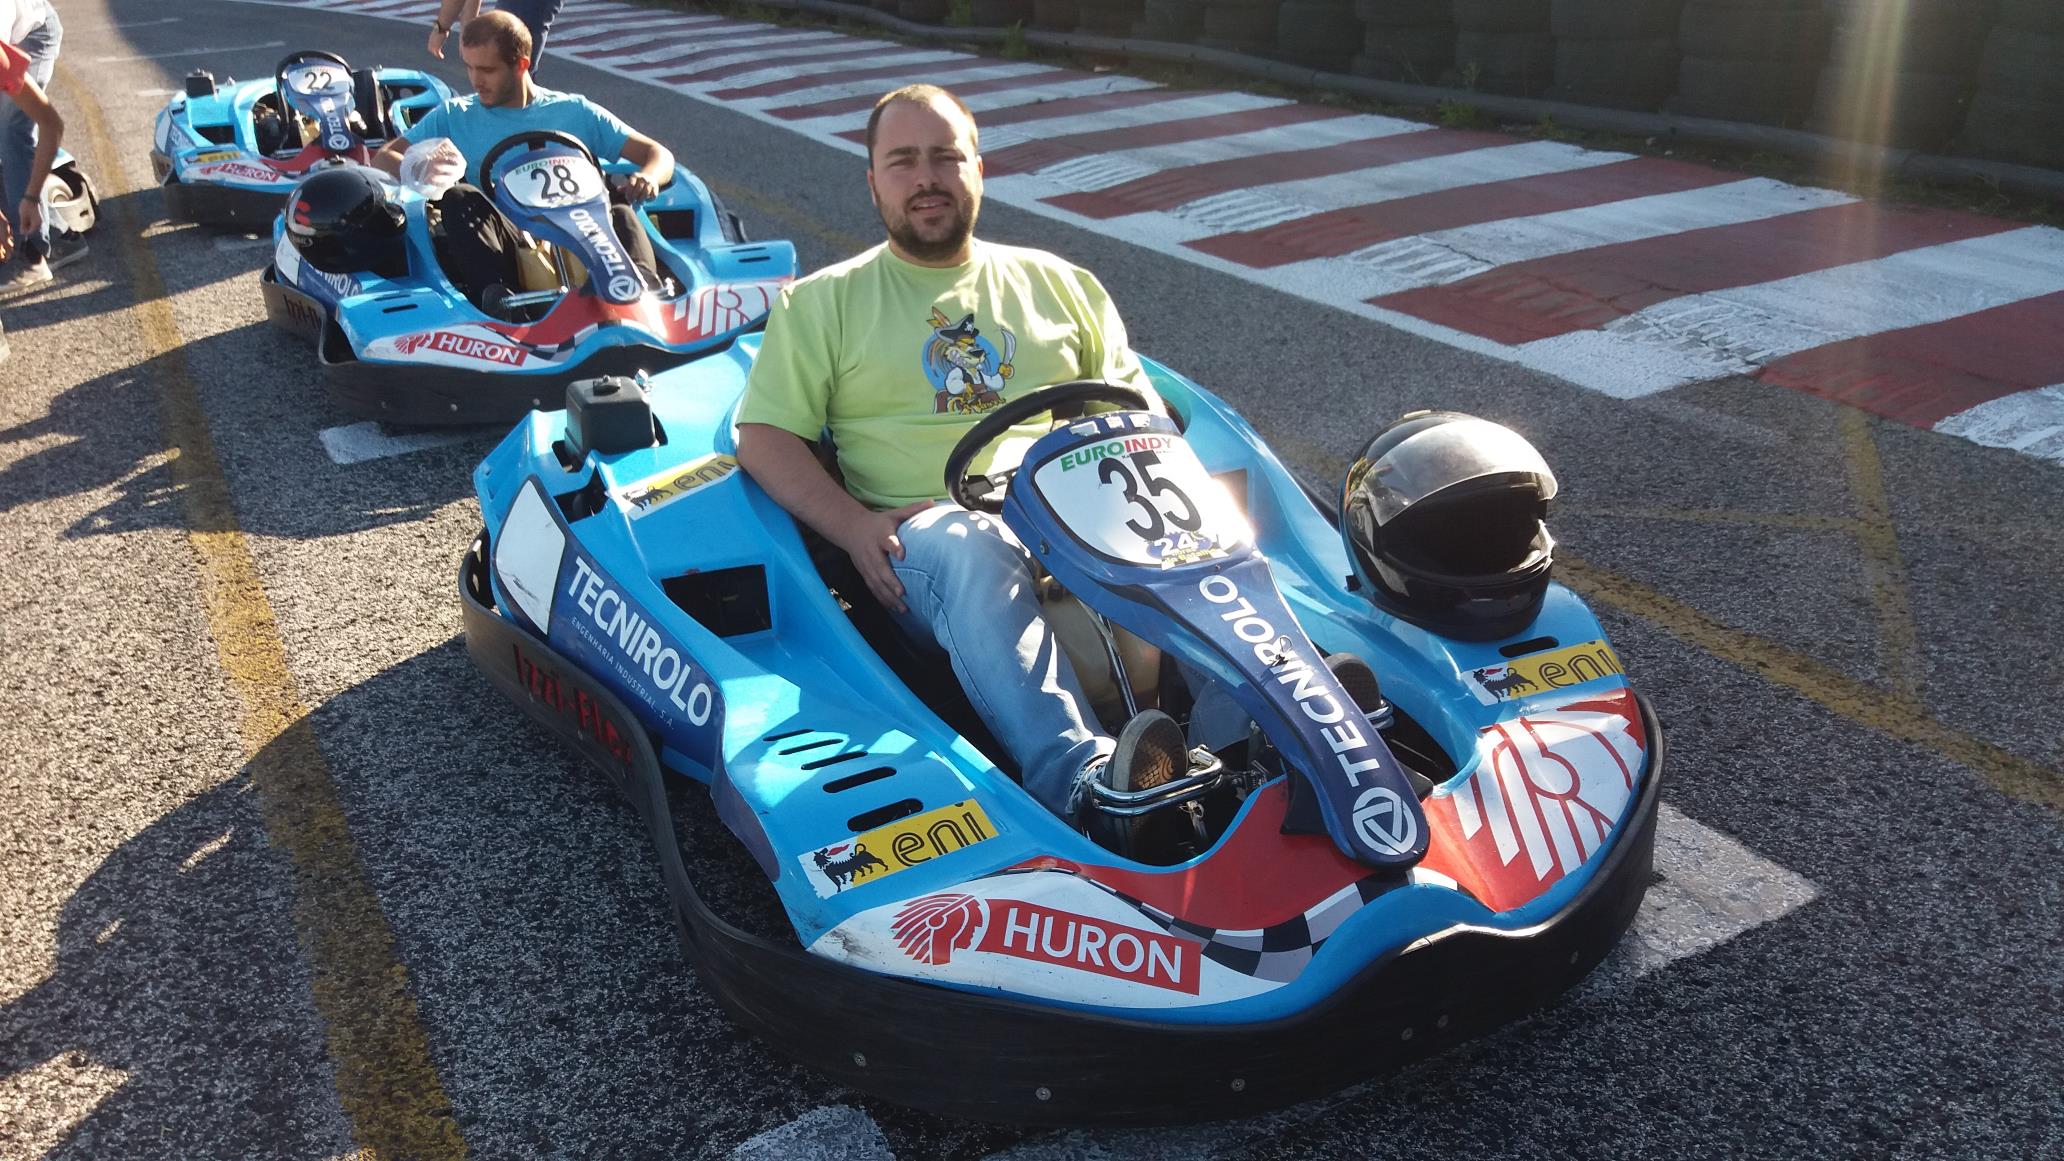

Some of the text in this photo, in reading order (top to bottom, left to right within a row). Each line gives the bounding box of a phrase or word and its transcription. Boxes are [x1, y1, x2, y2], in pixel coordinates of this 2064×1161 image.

[304, 71, 335, 90] 22
[530, 165, 580, 200] 28
[437, 333, 521, 364] HURON
[1059, 436, 1173, 472] EUROINDY
[1097, 449, 1202, 542] 35
[566, 554, 712, 727] TECNIROLO
[571, 616, 615, 665] ENGENHARIA
[1538, 641, 1620, 688] eni
[1199, 574, 1381, 788] TECNIROLO
[892, 801, 988, 867] eni
[1003, 906, 1183, 985] HURON
